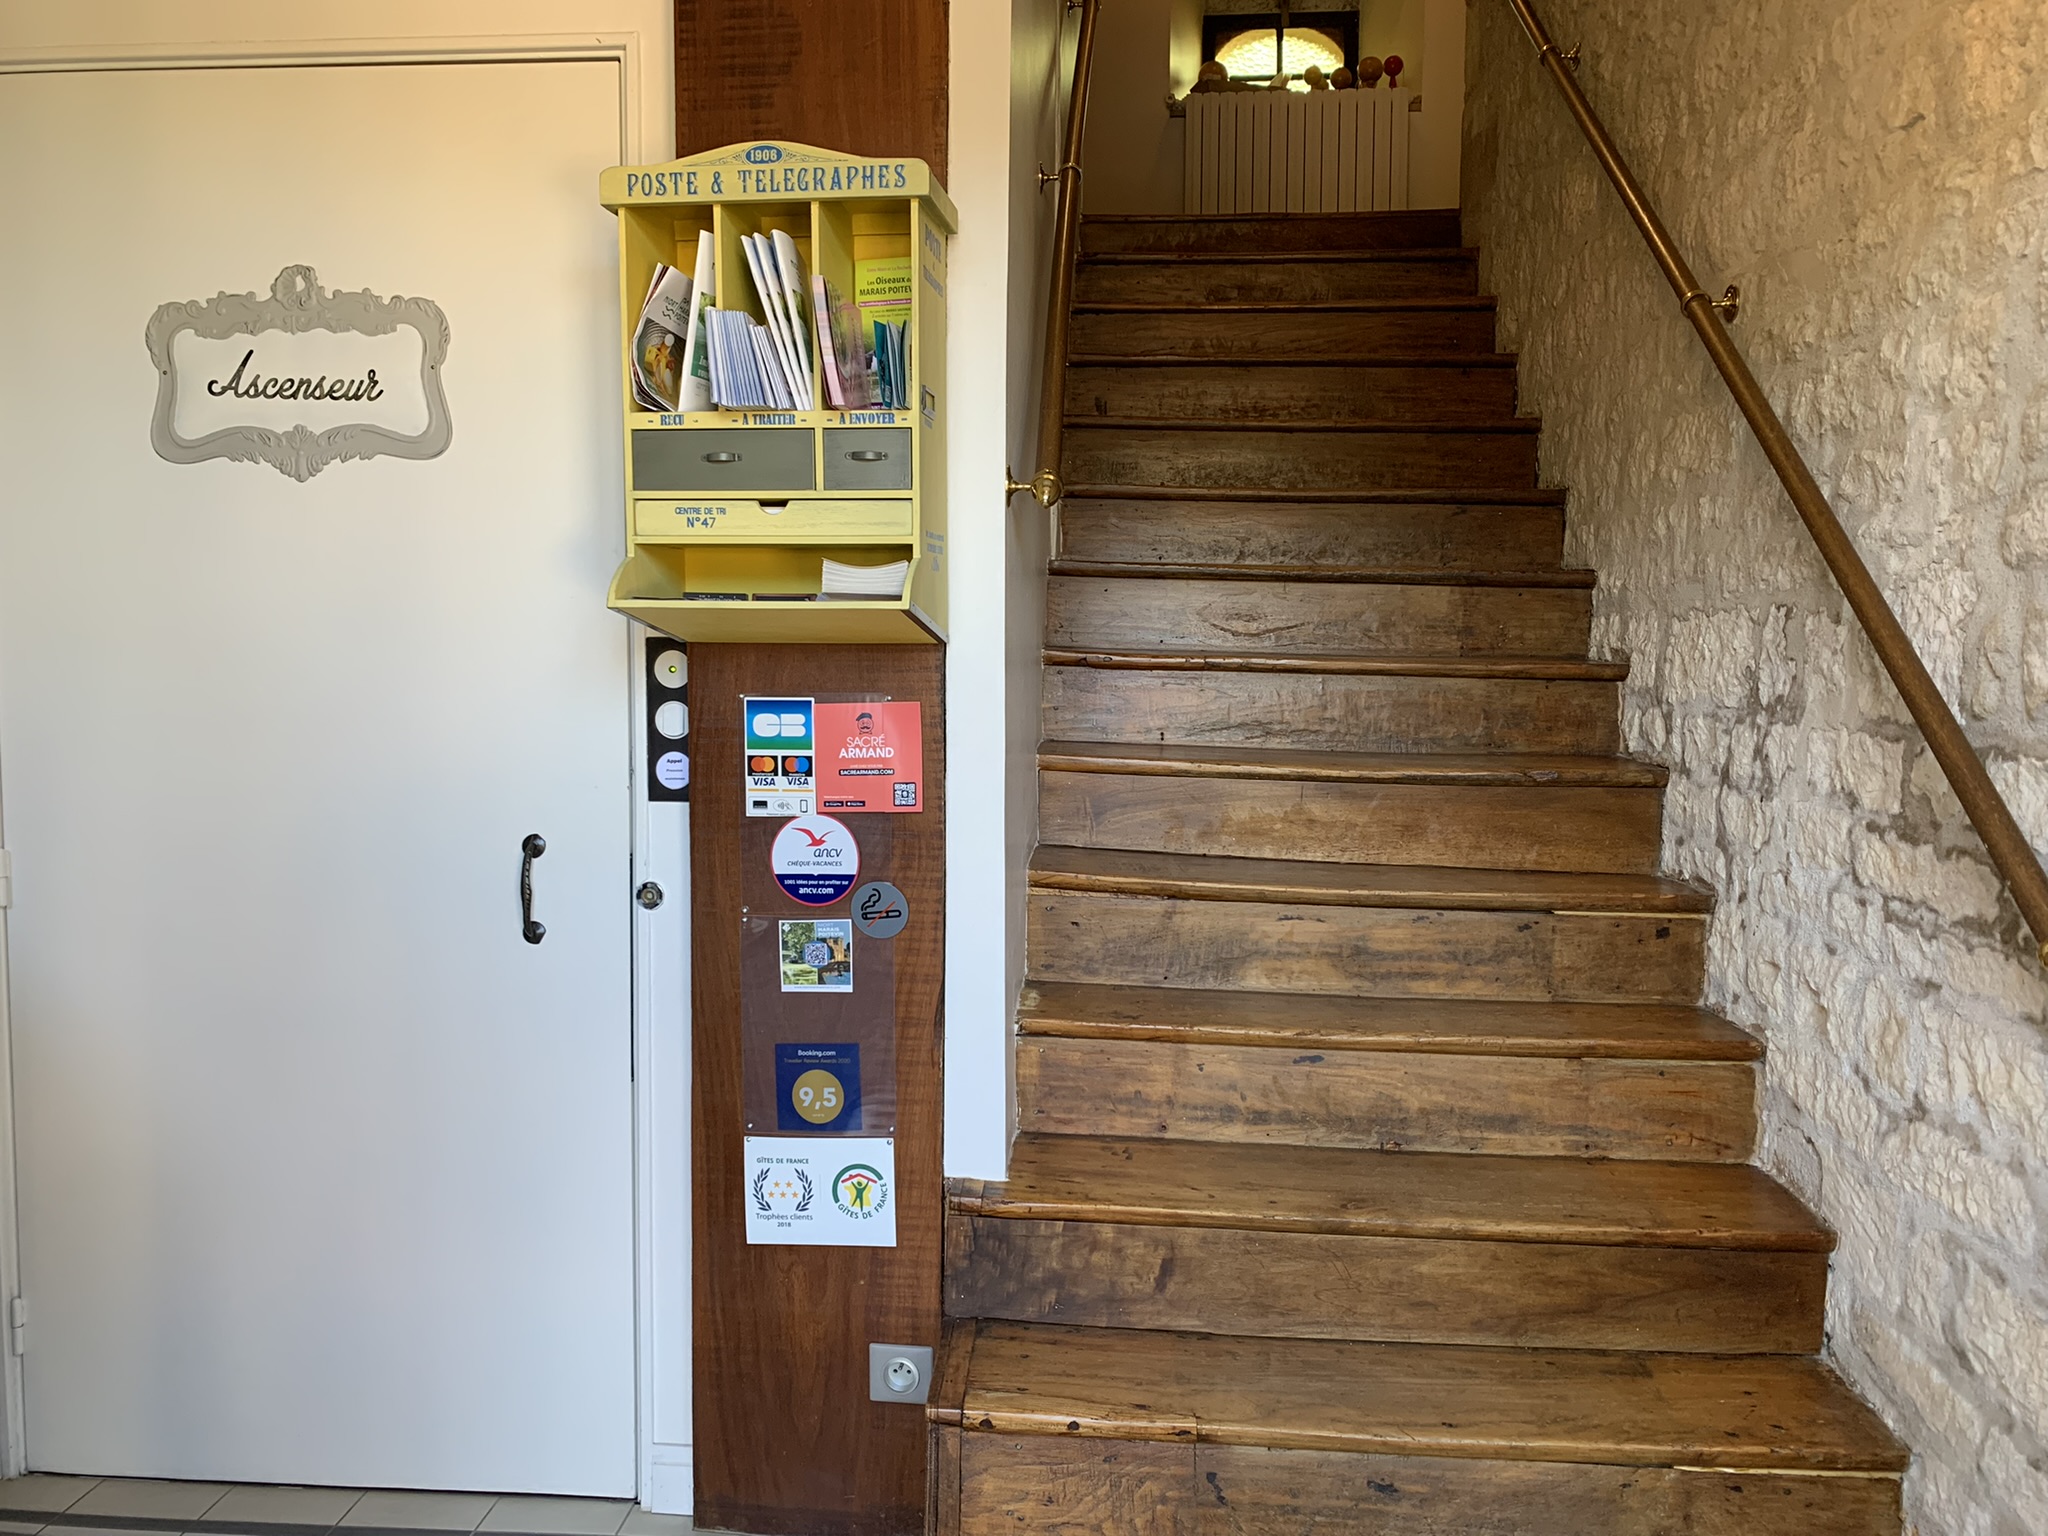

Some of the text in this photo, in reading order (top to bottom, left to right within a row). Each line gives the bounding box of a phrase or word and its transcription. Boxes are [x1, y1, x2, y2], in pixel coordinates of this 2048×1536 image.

[749, 149, 778, 162] 1906
[627, 164, 907, 197] POSTE & TELEGRAPHES
[876, 277, 906, 285] Oiseaux
[859, 287, 887, 296] MARAIS
[207, 349, 384, 402] Ascenseur
[752, 414, 796, 425] TRAITER
[849, 413, 895, 424] ENVOYER
[675, 507, 726, 515] CENTRE DE TRI
[847, 734, 885, 748] SACRÉ
[839, 747, 894, 759] ARMAND
[752, 777, 776, 786] VISA
[787, 777, 809, 786] VISA
[813, 848, 842, 858] ancv
[798, 887, 834, 895] ancv.com
[799, 1087, 837, 1110] 9,5
[862, 1210, 873, 1219] DE
[875, 1182, 888, 1213] FRANCE
